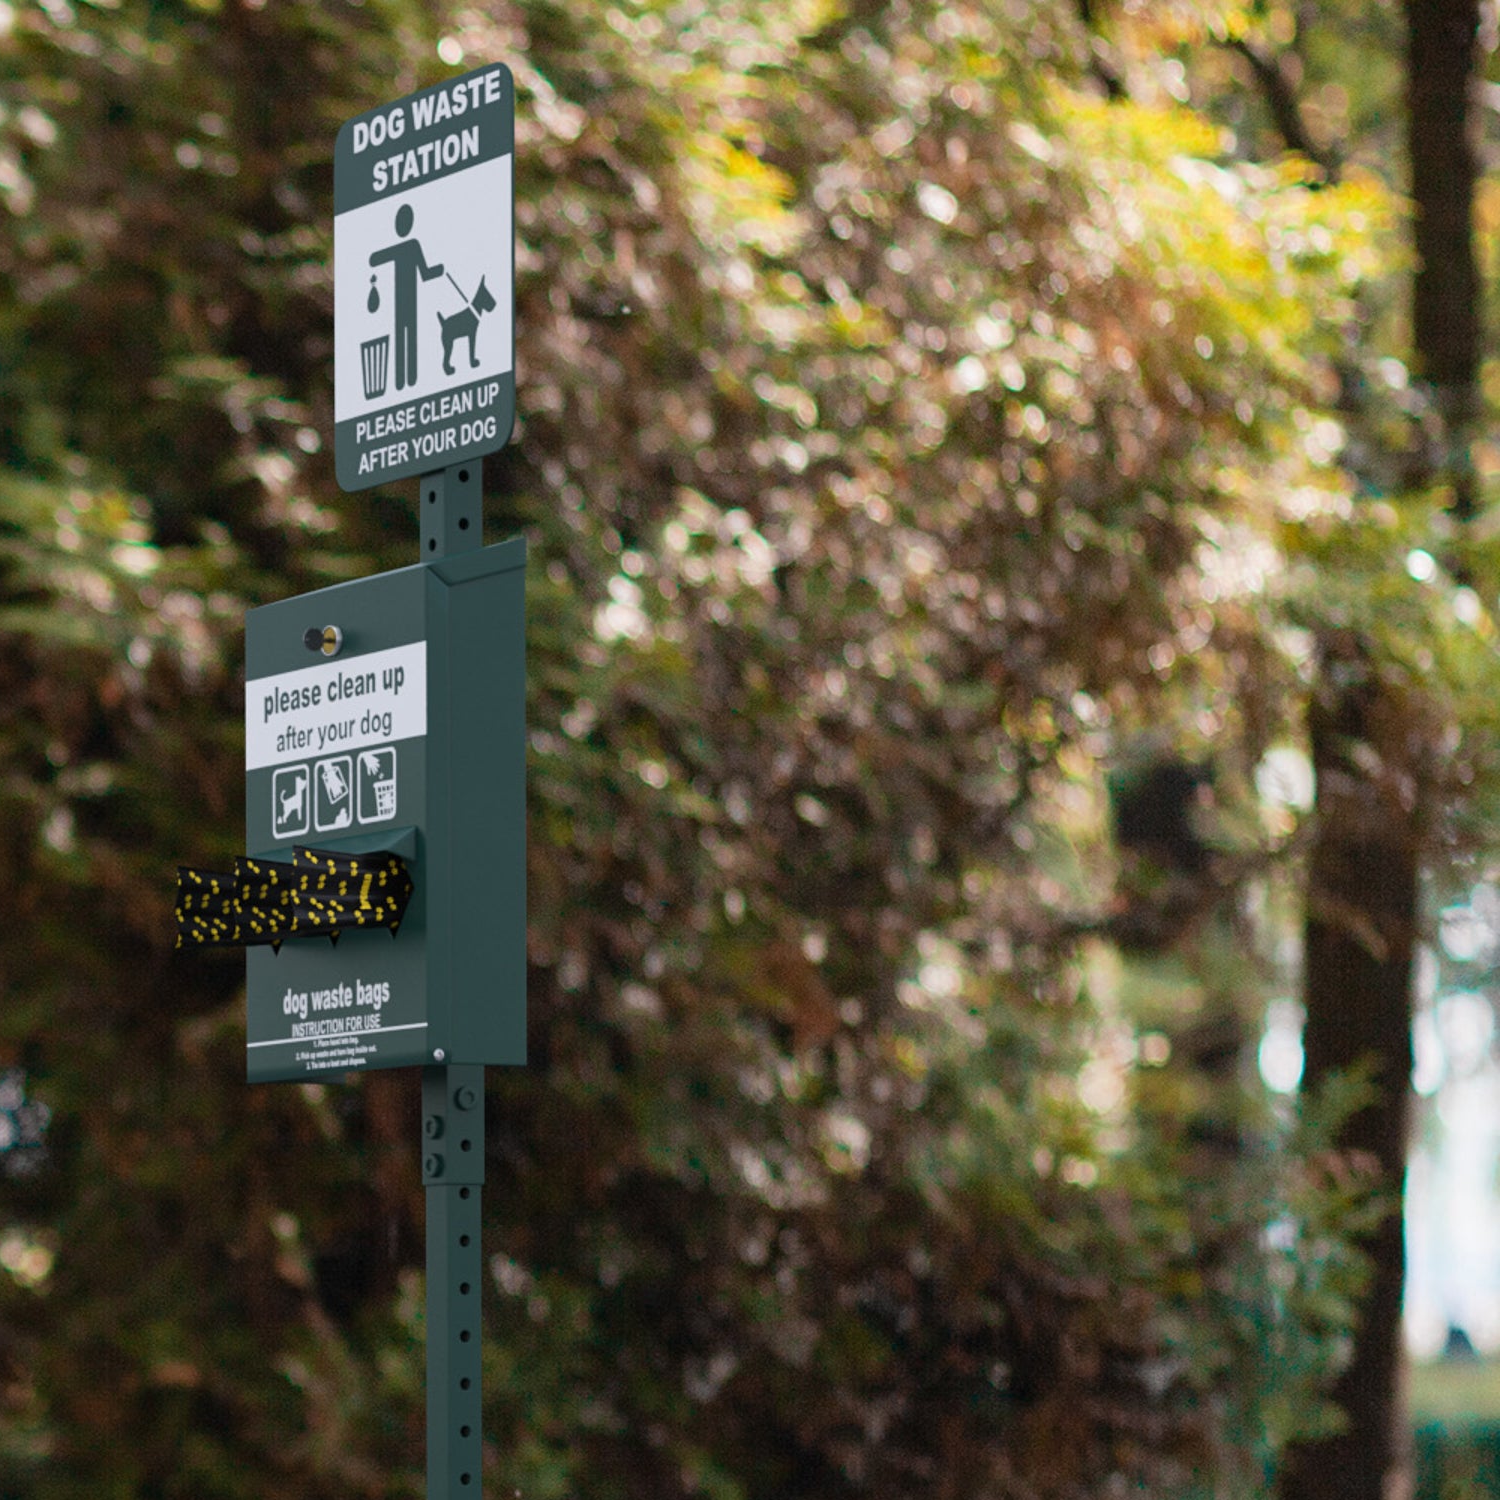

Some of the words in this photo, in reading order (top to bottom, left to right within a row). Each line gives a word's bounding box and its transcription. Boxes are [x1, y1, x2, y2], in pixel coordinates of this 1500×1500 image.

[353, 107, 406, 155] DOG
[411, 69, 501, 131] WASTE
[372, 125, 479, 192] STATION
[356, 406, 416, 444] PLEASE
[419, 389, 473, 425] CLEAN
[477, 382, 499, 408] UP
[358, 443, 409, 475] AFTER
[411, 428, 457, 460] YOUR
[460, 416, 497, 447] DOG
[264, 684, 322, 723] please
[327, 672, 376, 702] clean
[383, 665, 405, 695] up
[276, 725, 313, 752] after
[318, 718, 355, 751] your
[360, 708, 392, 737] dog
[283, 988, 308, 1019] dog
[311, 981, 353, 1011] waste
[356, 979, 390, 1010] bags
[292, 1018, 344, 1038] INSTRUCTION
[345, 1016, 362, 1032] FOR
[364, 1013, 382, 1029] USE
